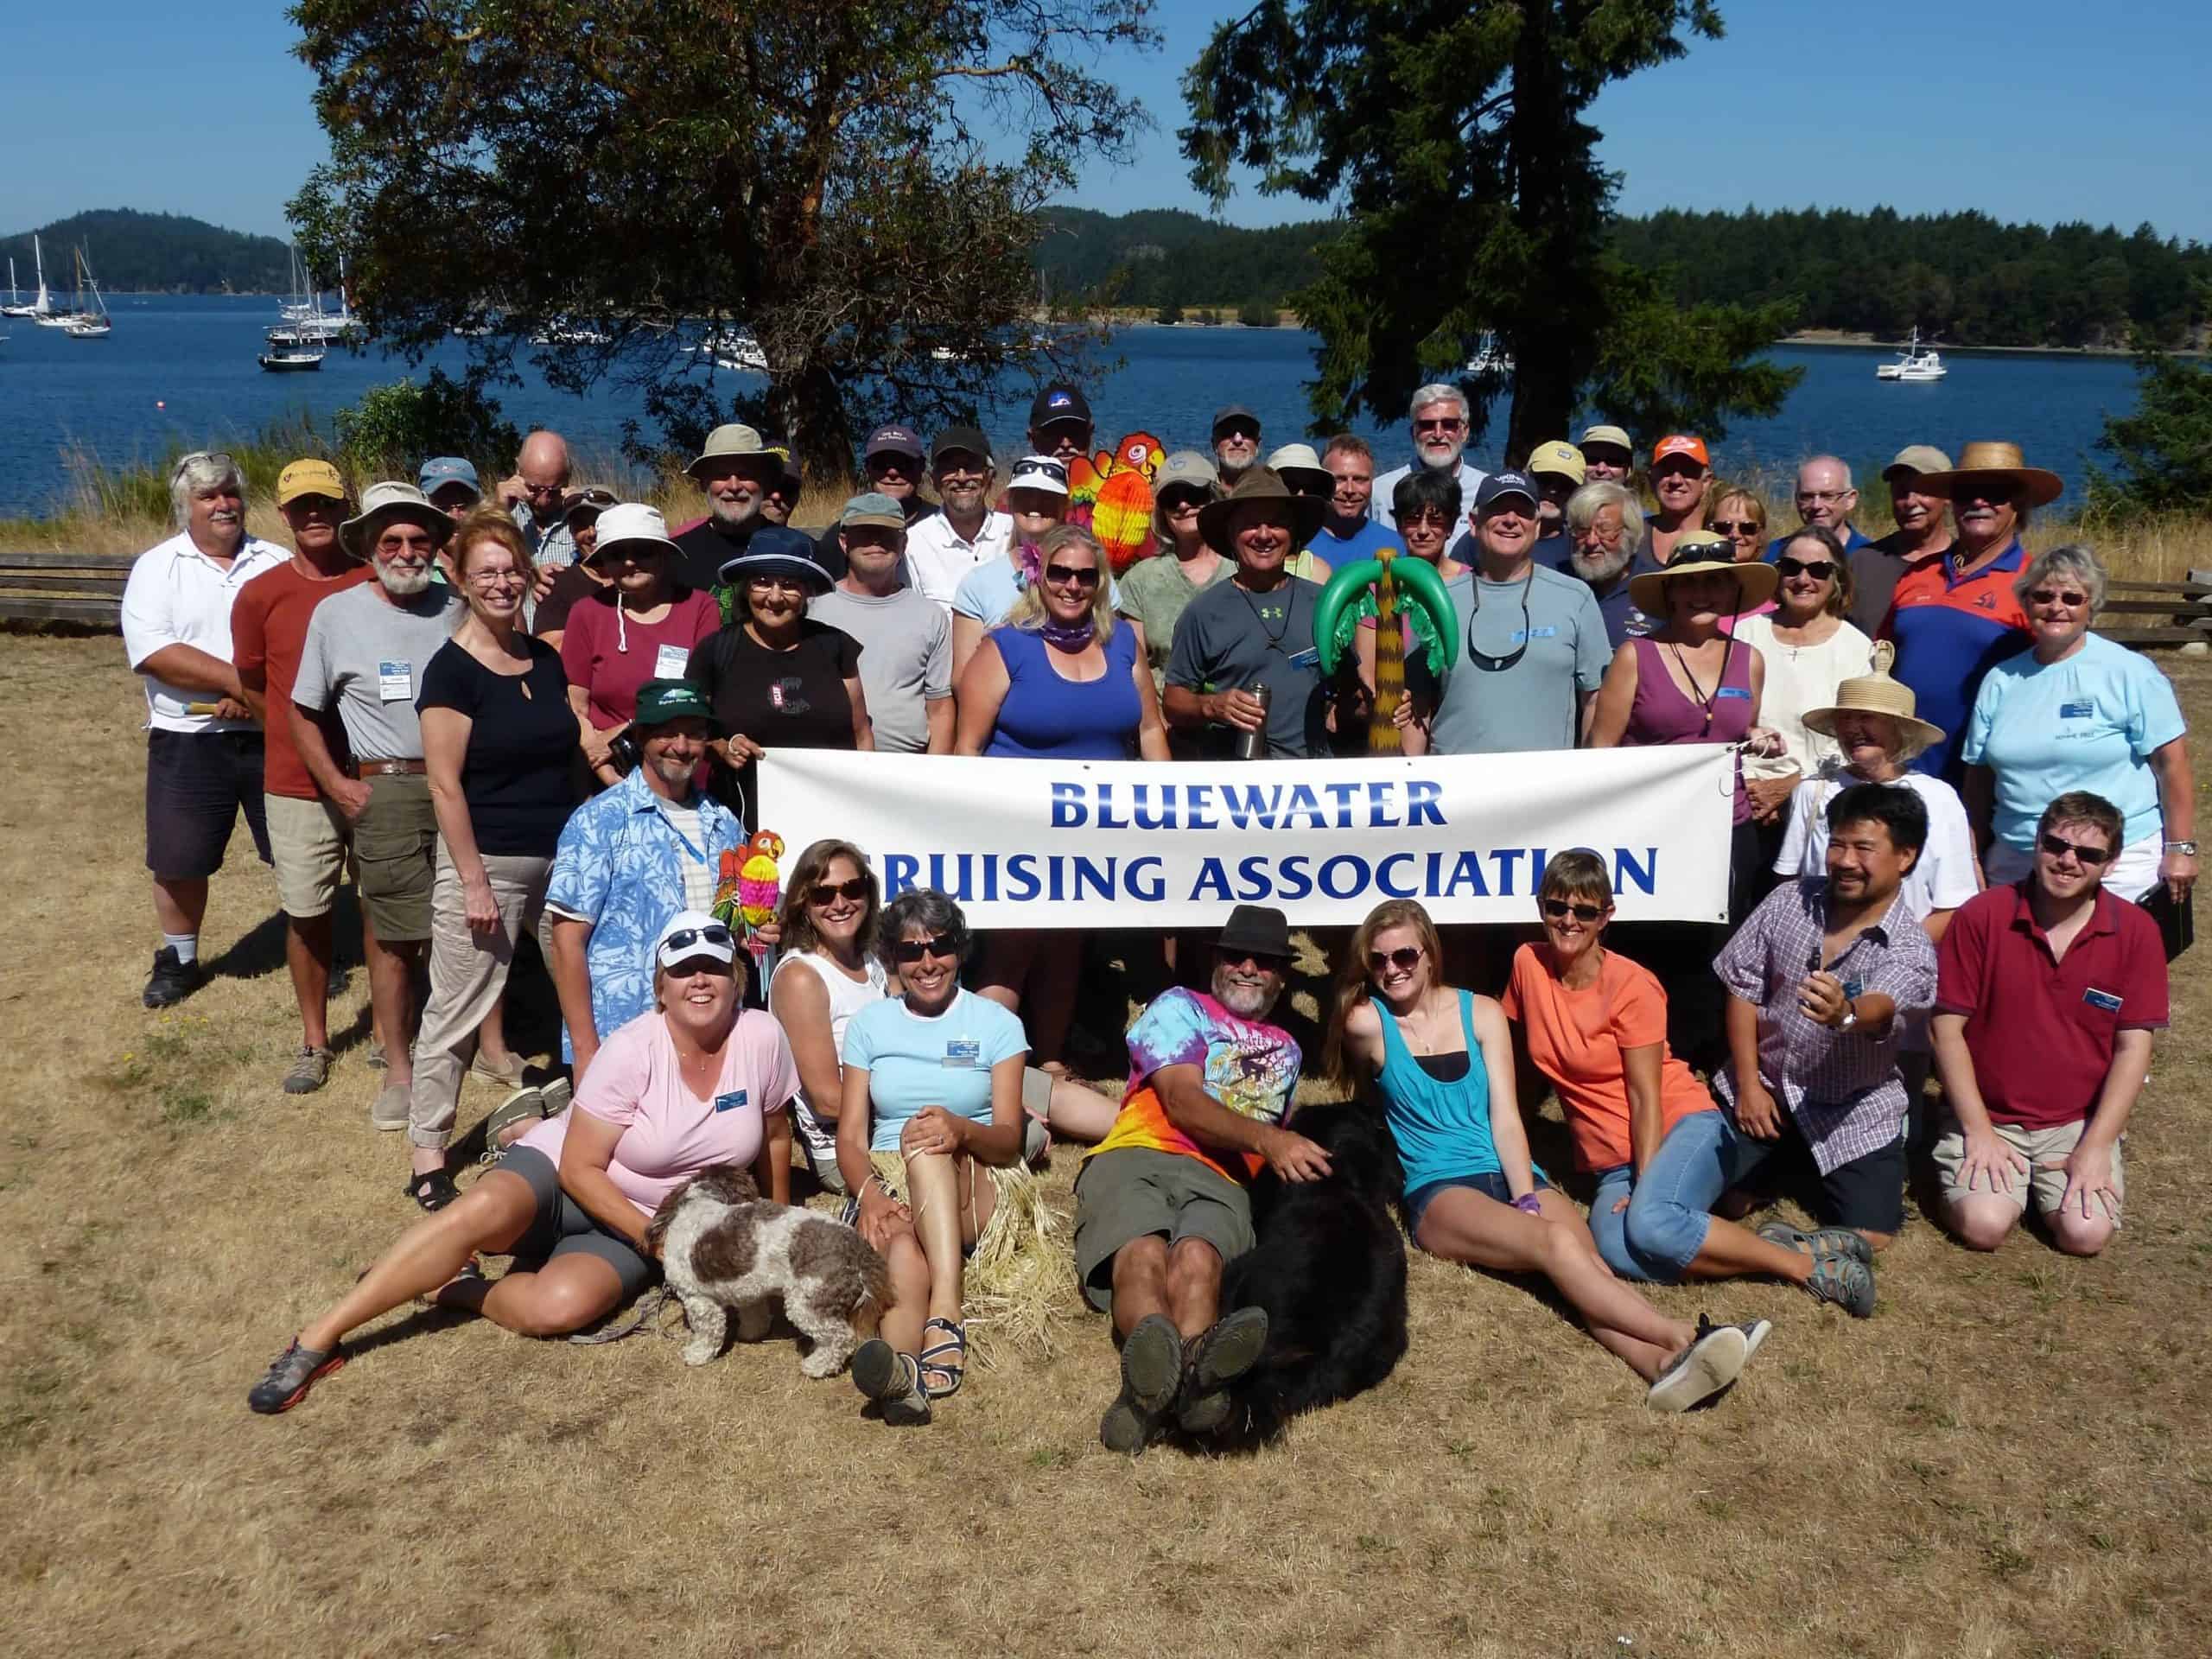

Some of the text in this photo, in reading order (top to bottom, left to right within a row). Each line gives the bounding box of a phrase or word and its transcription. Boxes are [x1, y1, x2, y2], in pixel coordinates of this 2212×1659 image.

[1050, 780, 1448, 830] BLUEWATER
[865, 847, 1658, 902] RUISING ASSOCIATIN
